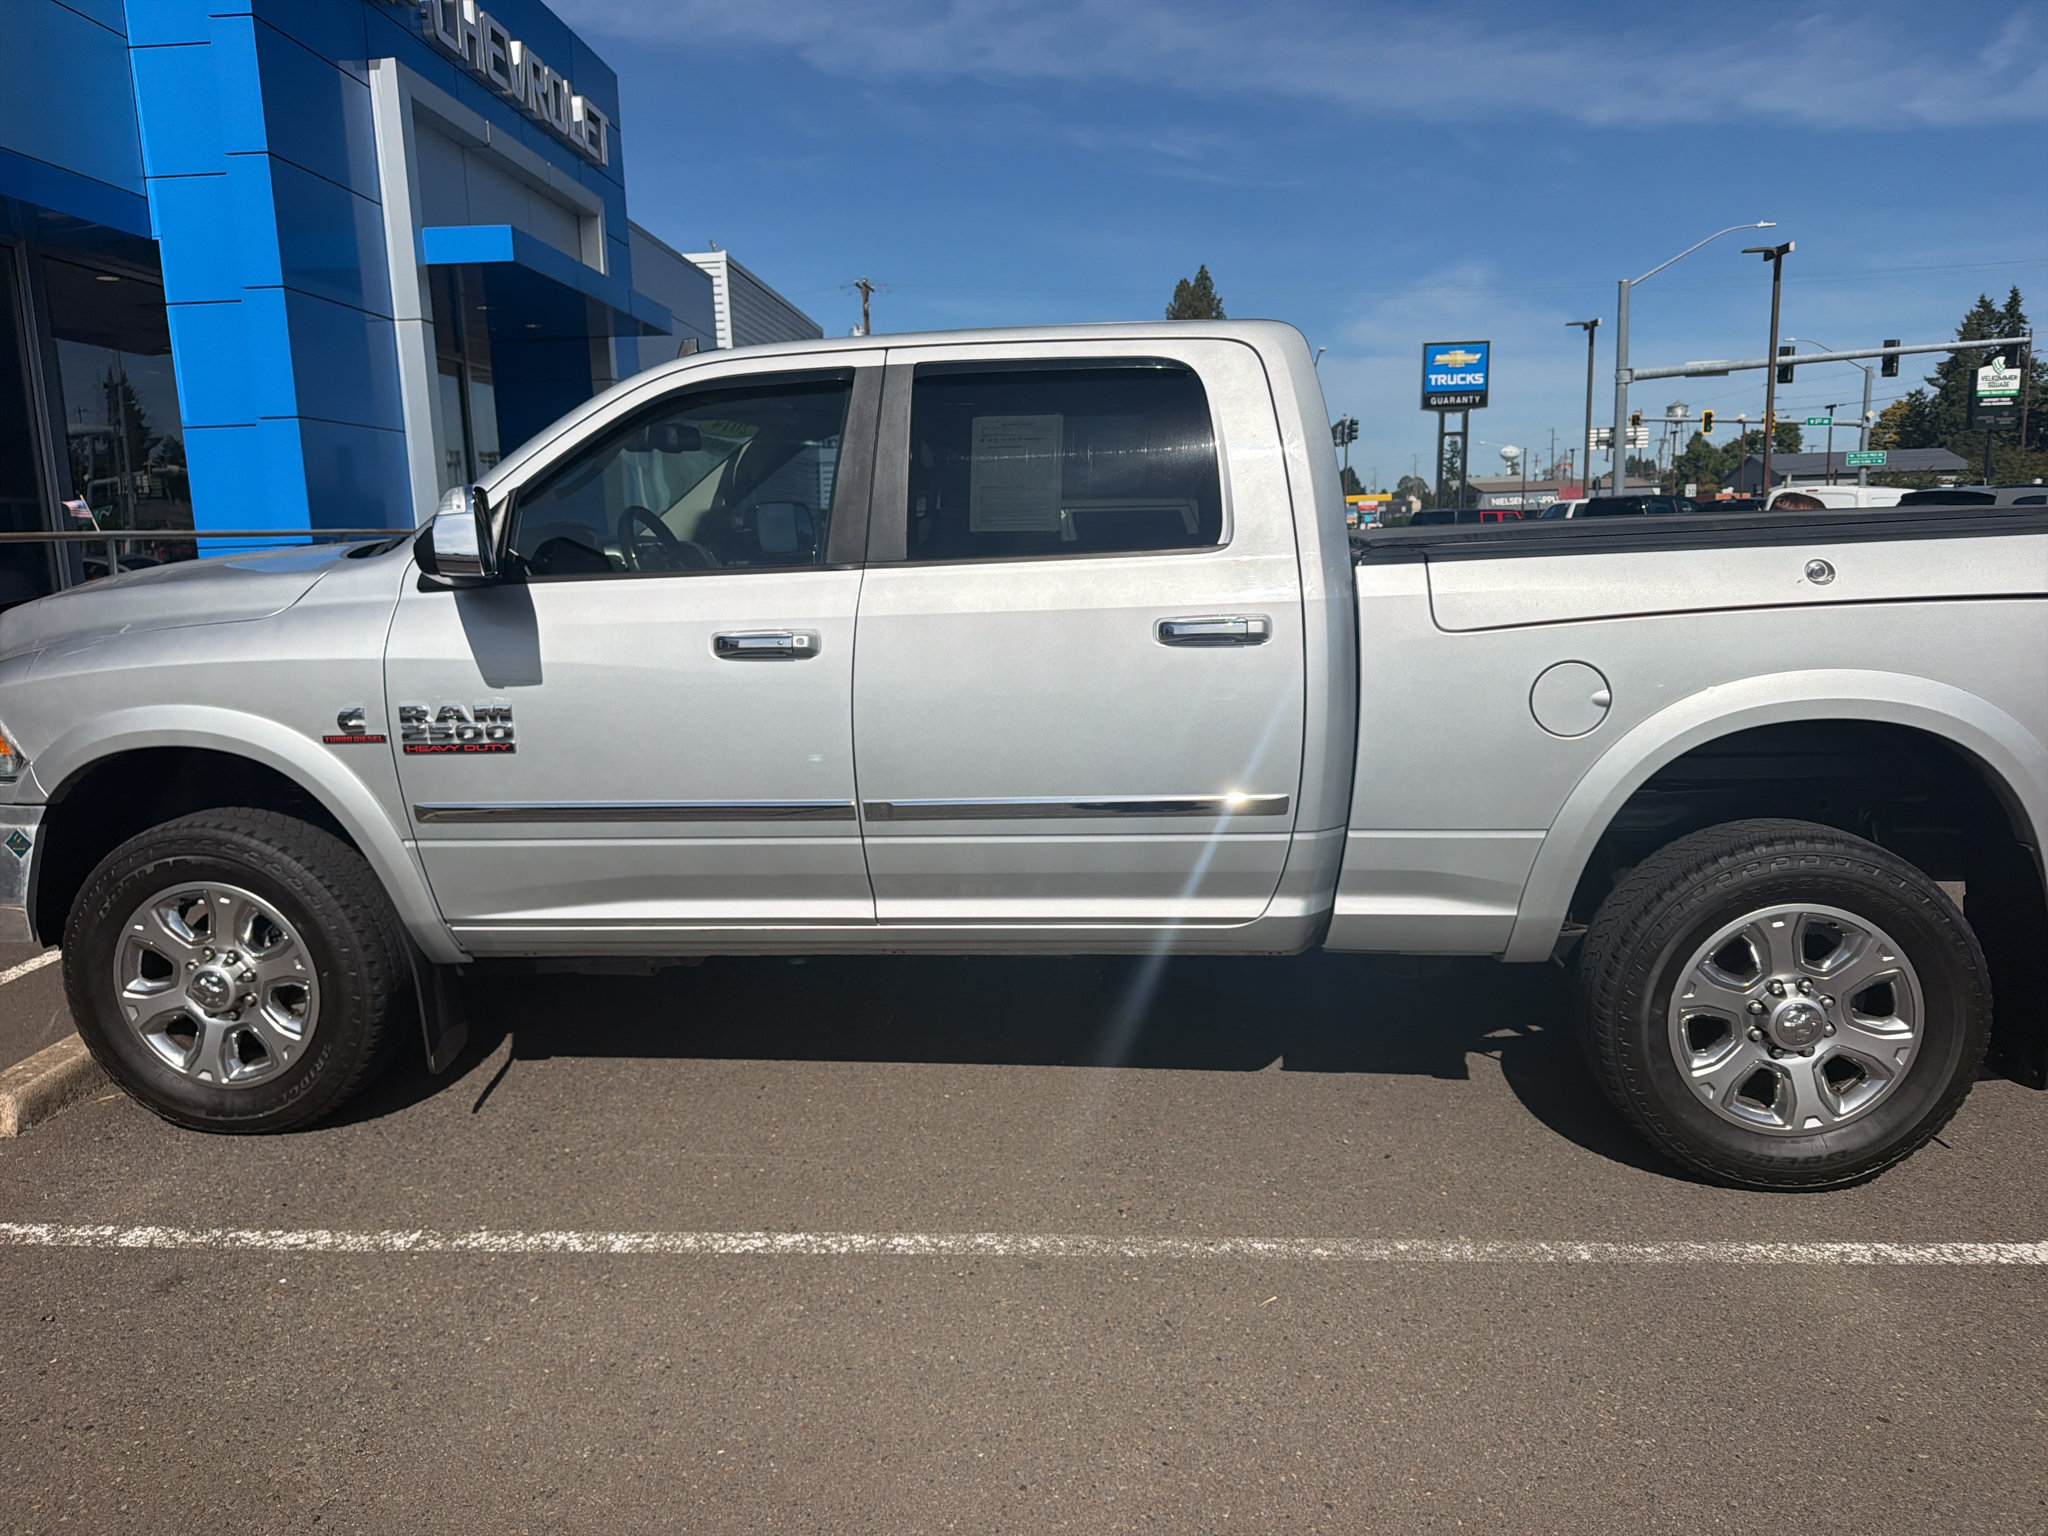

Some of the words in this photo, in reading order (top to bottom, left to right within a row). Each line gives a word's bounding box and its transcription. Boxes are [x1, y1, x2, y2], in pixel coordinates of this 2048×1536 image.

[1428, 372, 1484, 386] TRUCKS
[1430, 395, 1481, 405] GUARANTY
[399, 704, 513, 723] RAM
[402, 722, 515, 744] 2500
[406, 744, 459, 752] HEAVY
[463, 744, 510, 752] DUTY
